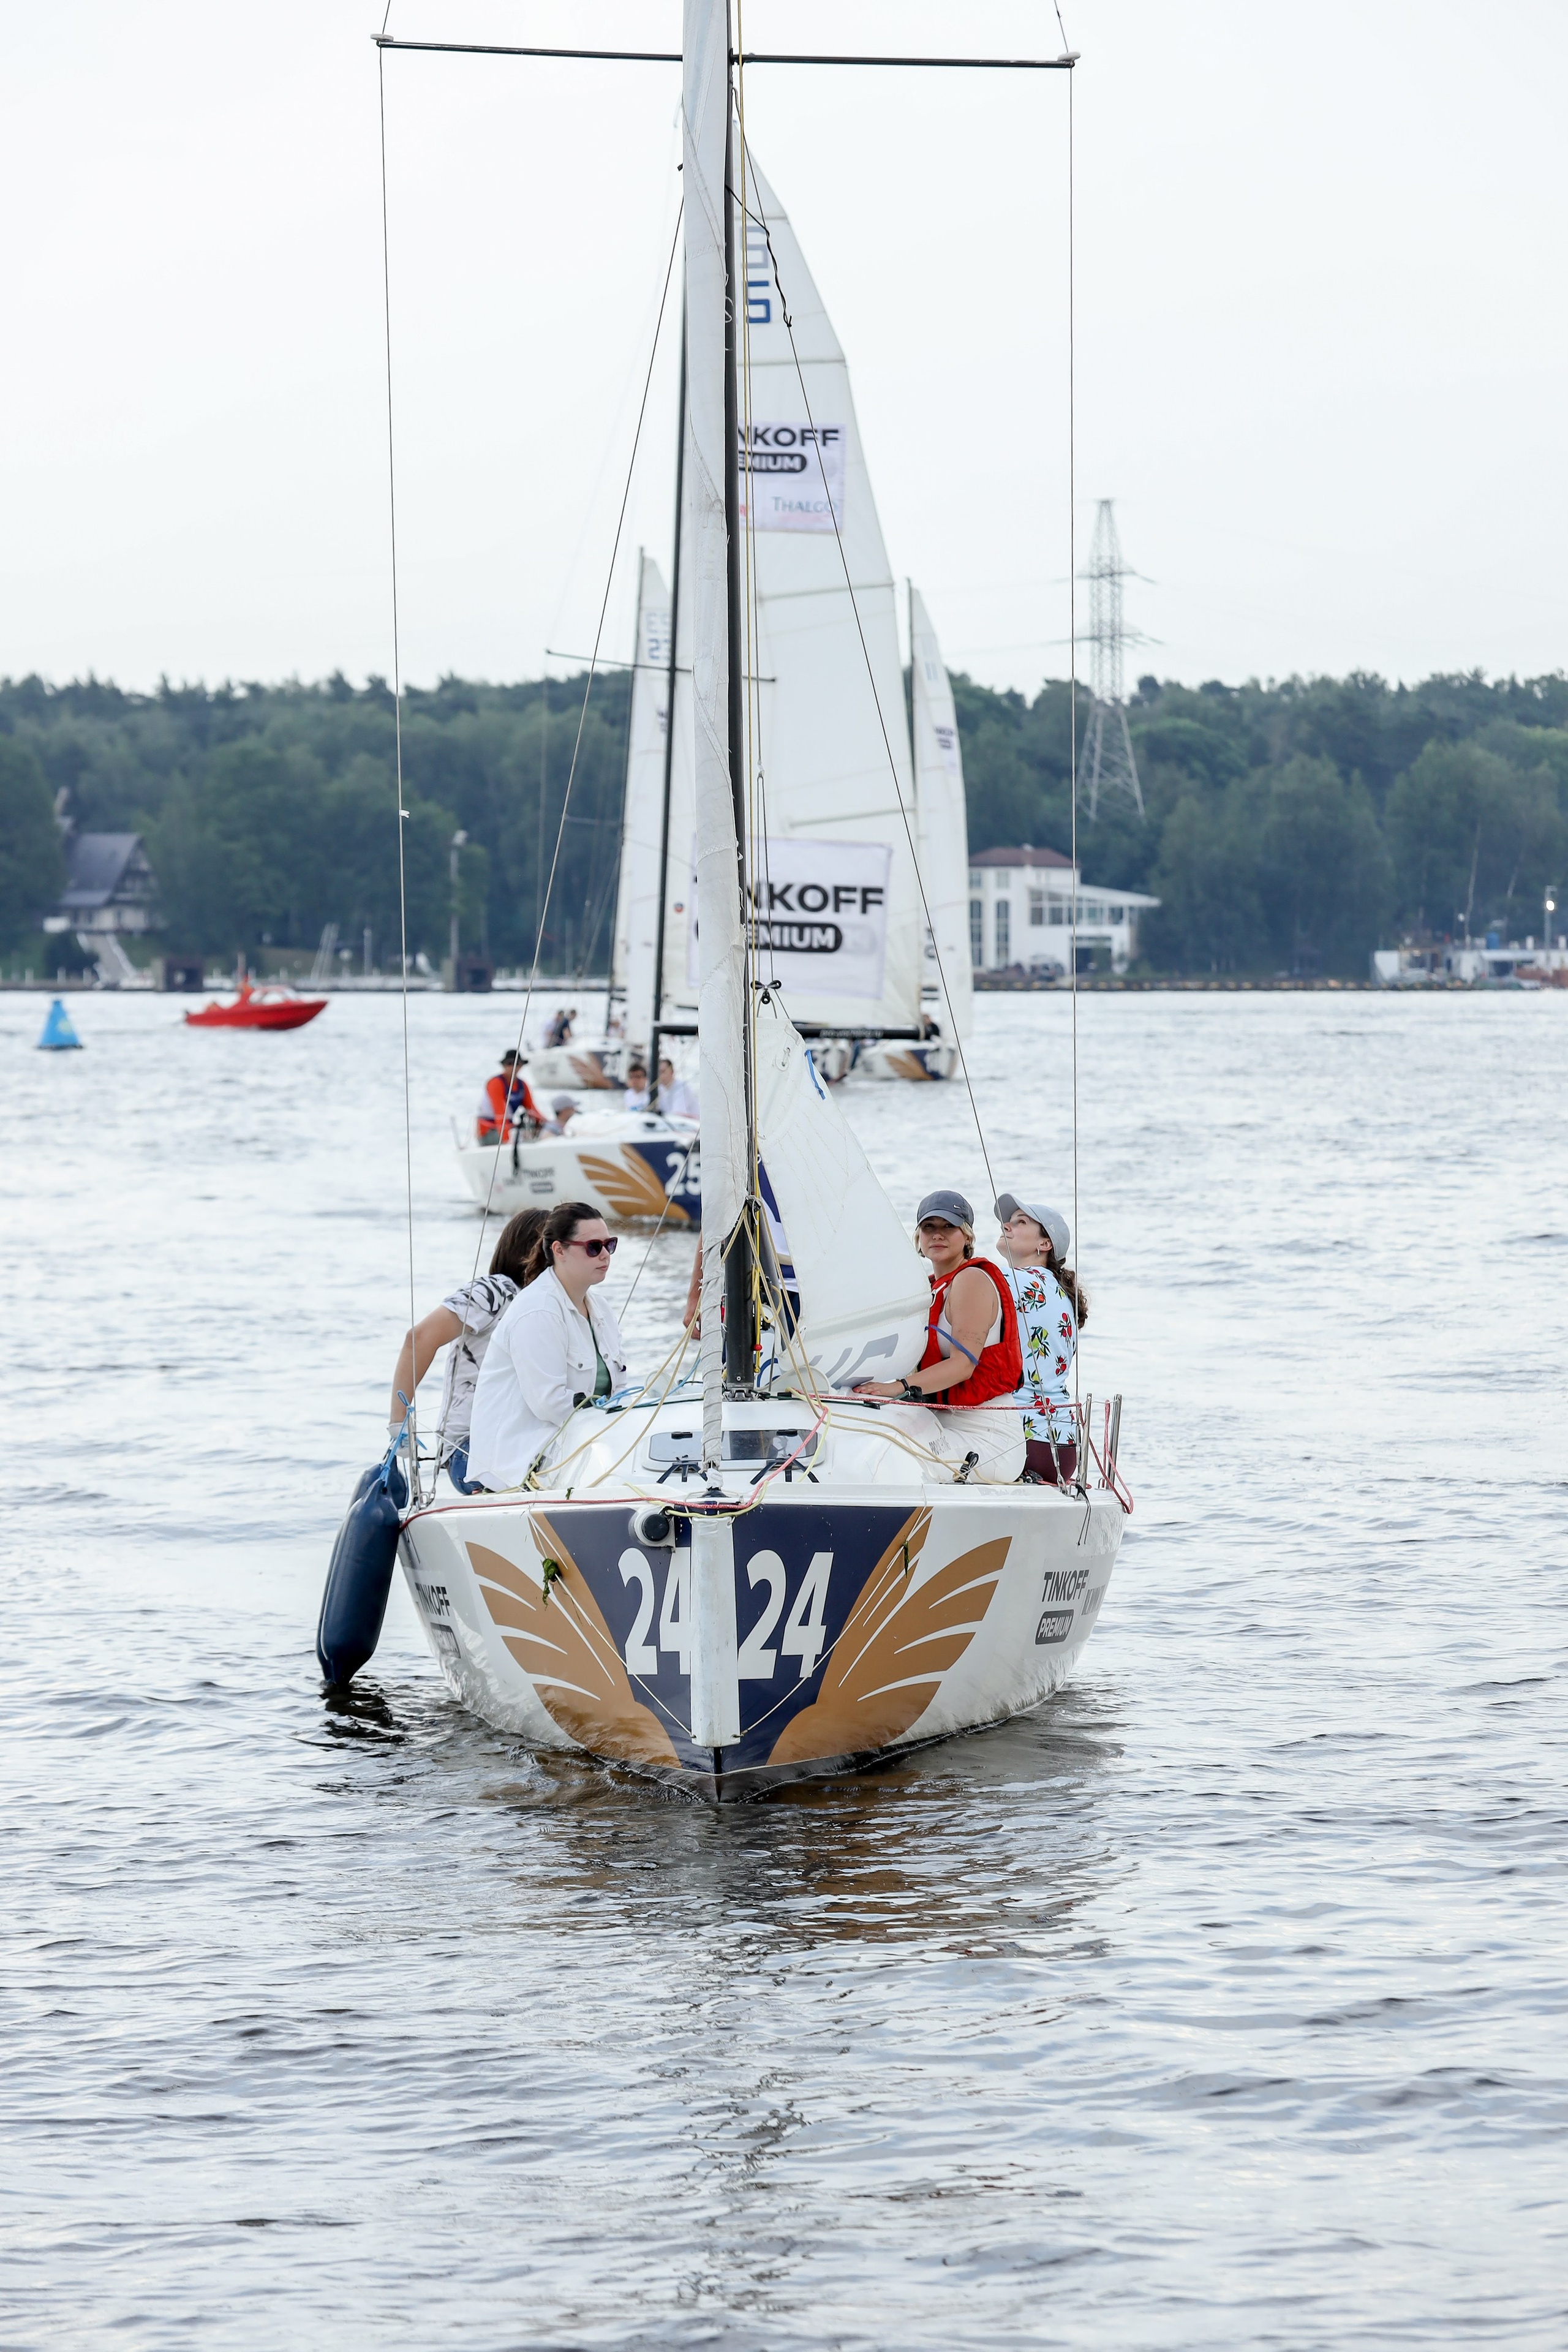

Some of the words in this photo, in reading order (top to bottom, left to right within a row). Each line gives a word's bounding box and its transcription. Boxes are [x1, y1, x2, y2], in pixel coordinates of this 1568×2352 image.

[738, 427, 839, 447] NKOFF
[739, 454, 802, 470] EMIUM
[747, 883, 884, 914] NKOFF
[748, 924, 835, 949] EMIUM
[665, 1152, 701, 1196] 25
[415, 1582, 450, 1616] TINKOFF
[1041, 1569, 1090, 1602] TINKOFF
[617, 1547, 691, 1675] 24
[737, 1549, 834, 1679] 24
[1038, 1616, 1073, 1638] PREMIUM
